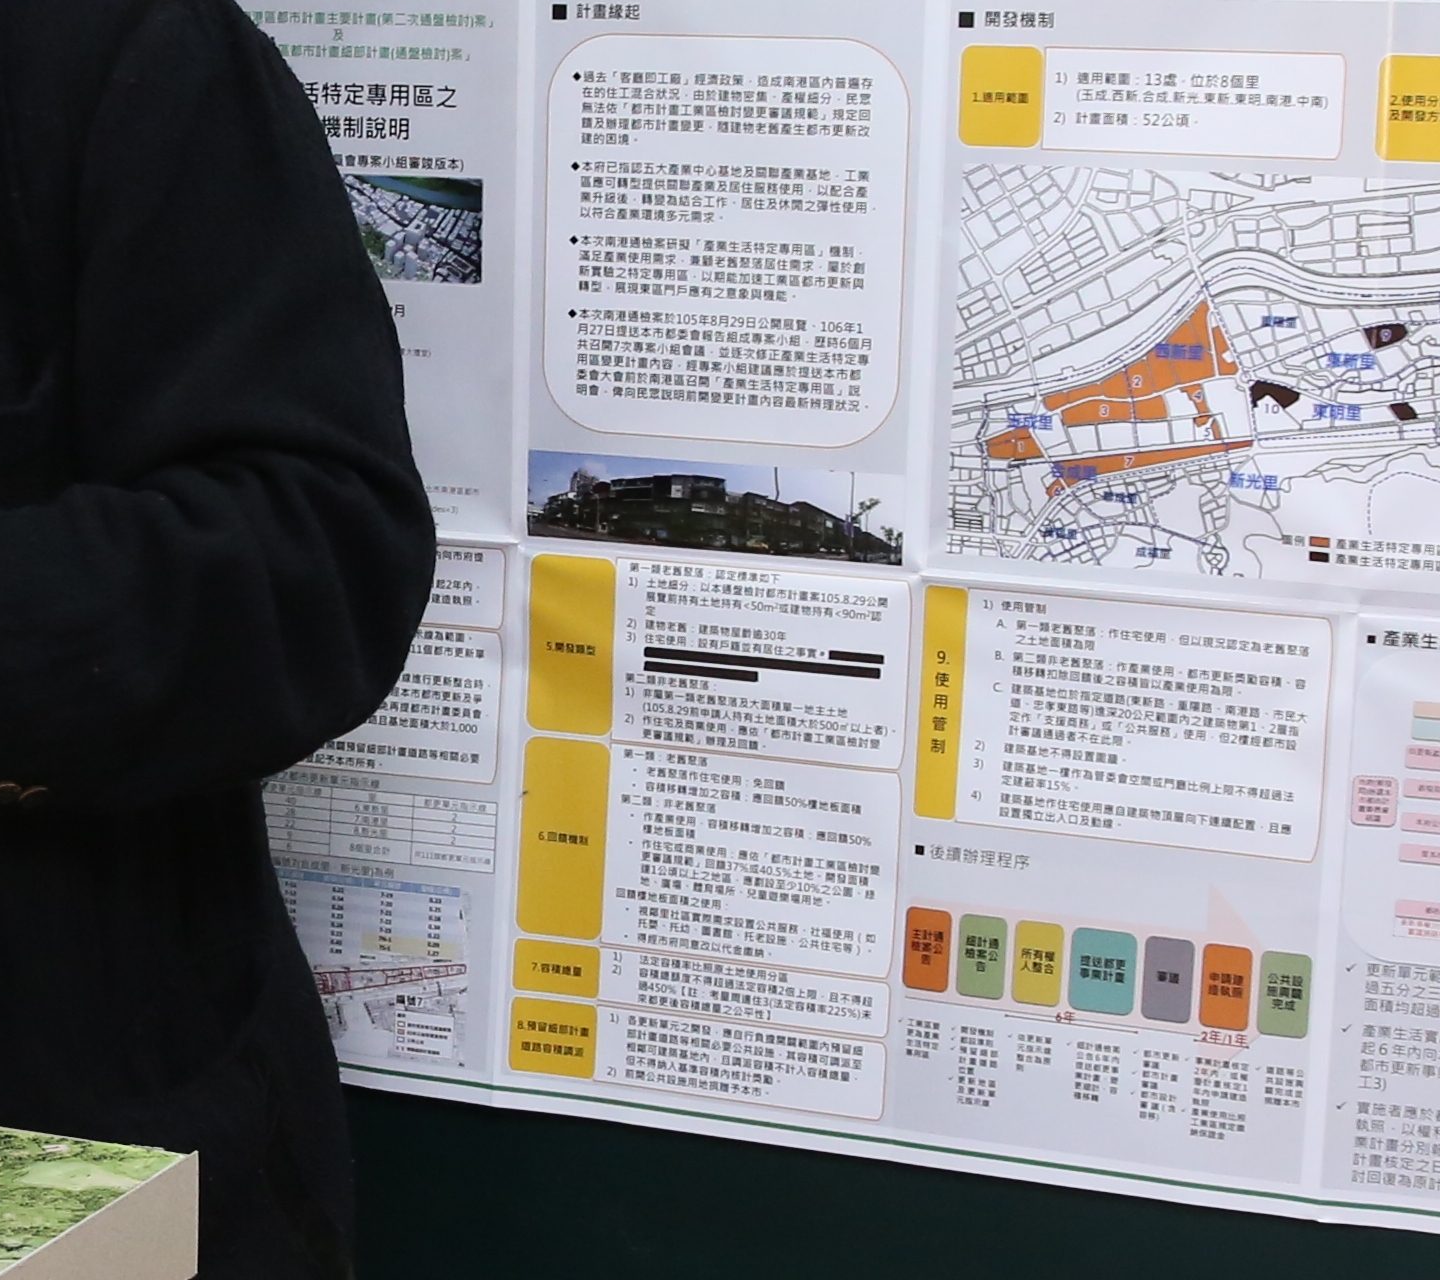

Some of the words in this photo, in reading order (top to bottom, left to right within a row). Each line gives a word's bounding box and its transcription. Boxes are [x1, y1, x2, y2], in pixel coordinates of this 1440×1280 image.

[576, 4, 641, 20] 計畫緣起
[984, 11, 1055, 29] 開發機制
[333, 28, 344, 41] 及
[1055, 72, 1068, 86] 1)
[1053, 112, 1067, 126] 2)
[1311, 404, 1361, 421] 東明里
[1229, 471, 1279, 491] 新光里
[983, 599, 994, 612] 1)
[929, 844, 1030, 870] 後續辦理程序
